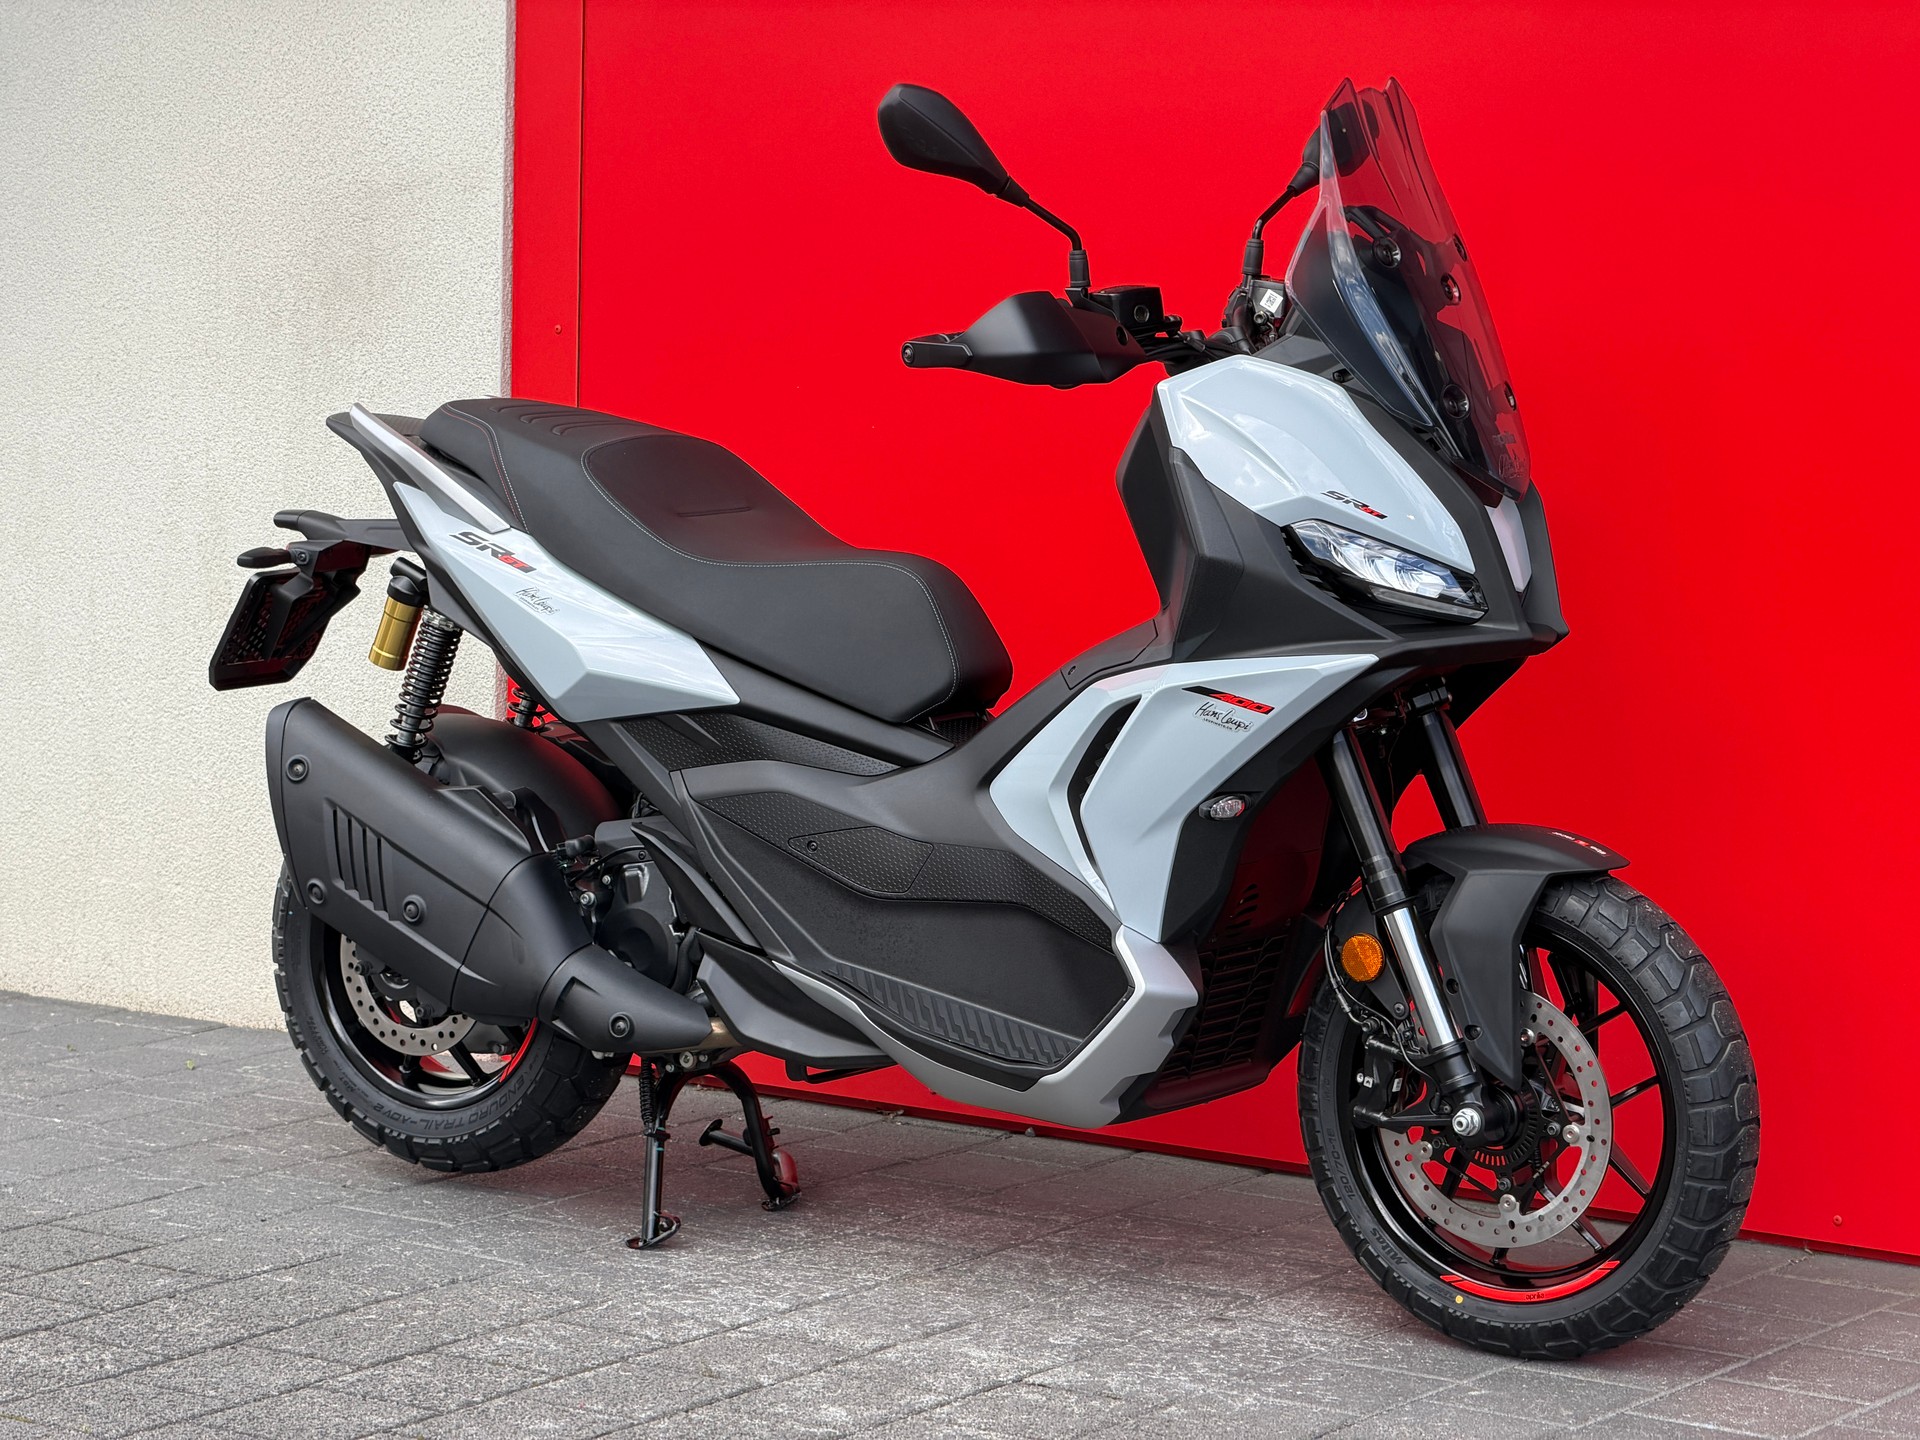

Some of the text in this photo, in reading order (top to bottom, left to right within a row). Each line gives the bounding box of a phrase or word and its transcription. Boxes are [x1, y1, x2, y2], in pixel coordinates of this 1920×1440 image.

[1194, 701, 1223, 720] Hans
[1208, 692, 1275, 715] 400
[1369, 1227, 1408, 1266] Mitas
